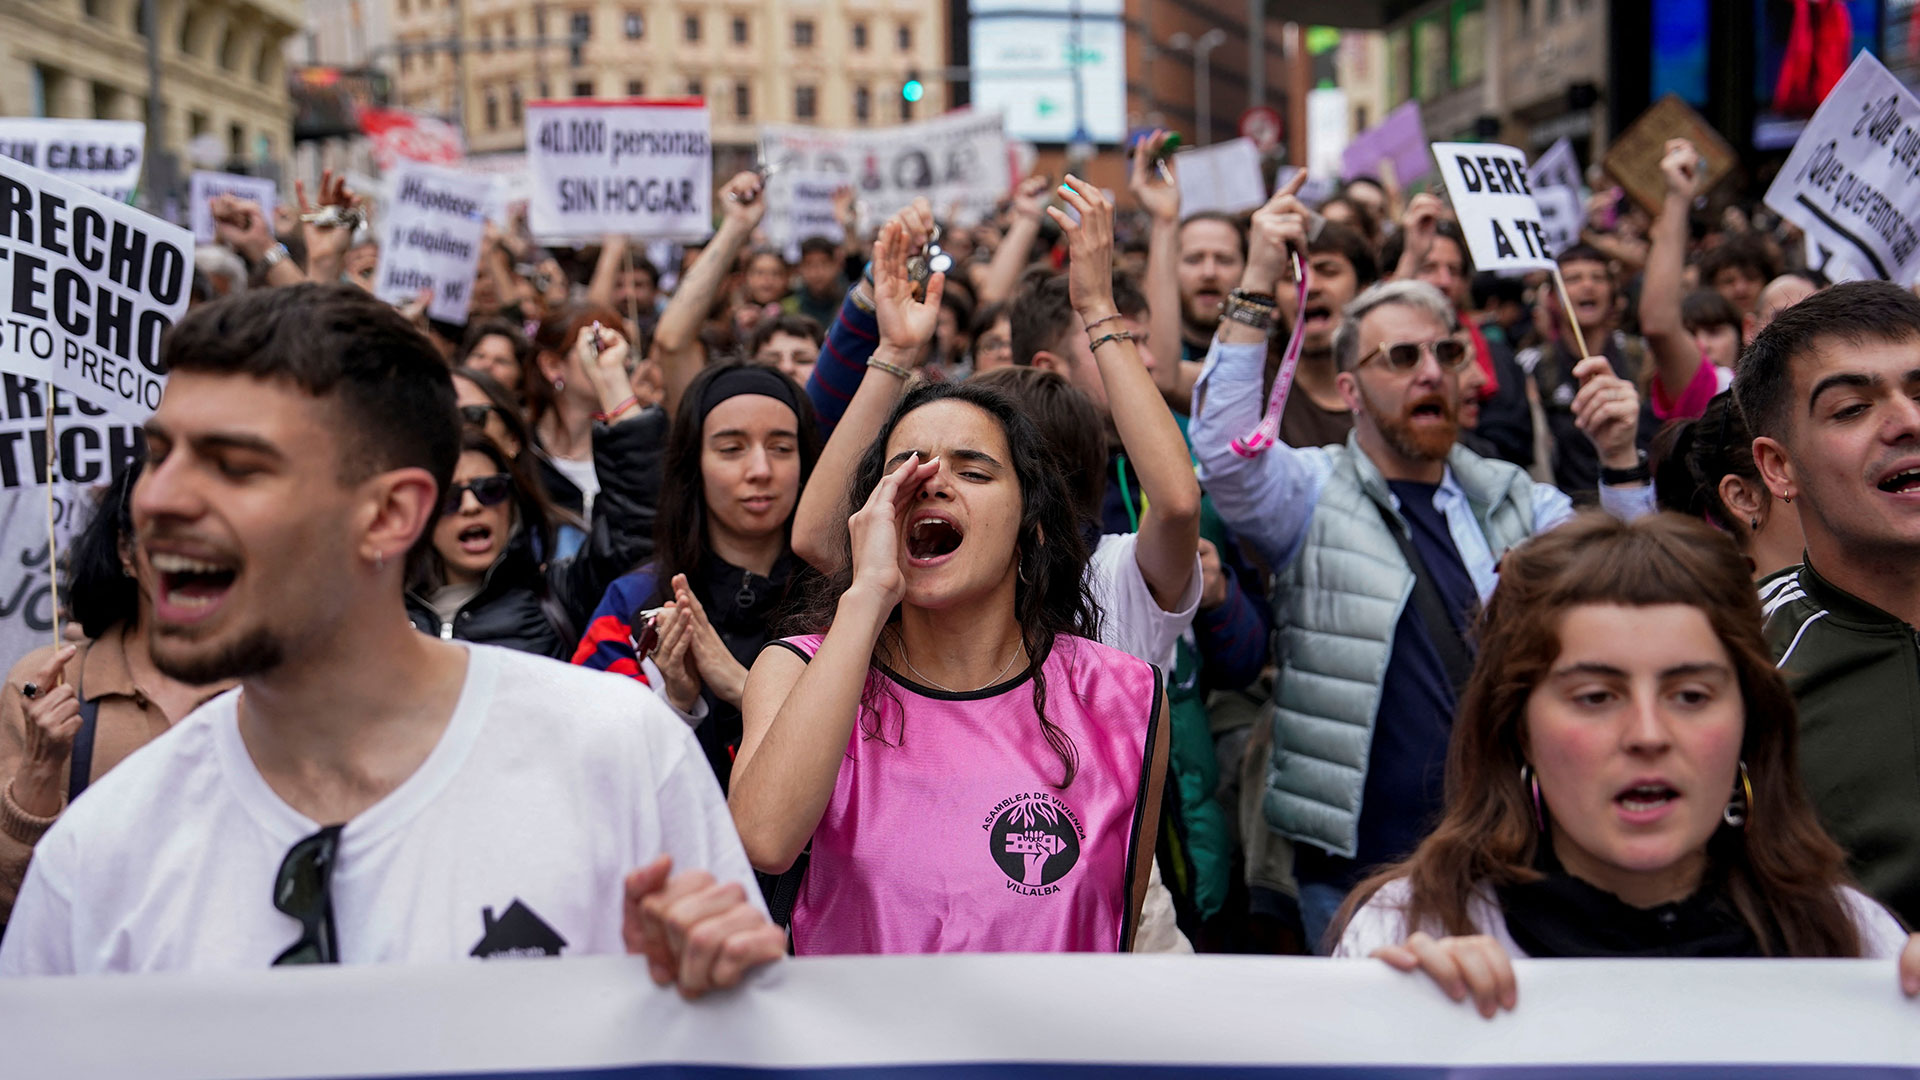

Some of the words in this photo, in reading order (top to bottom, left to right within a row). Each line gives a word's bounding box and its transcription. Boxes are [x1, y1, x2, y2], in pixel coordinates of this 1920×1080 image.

[47, 143, 136, 171] CASA?
[538, 119, 606, 155] 40.000
[611, 129, 711, 166] personas
[558, 177, 597, 214] SIN
[0, 174, 185, 306] RECHO
[1492, 218, 1519, 259] A
[0, 247, 173, 377] ECHO
[0, 316, 54, 360] TO
[64, 337, 162, 412] PRECIO
[982, 792, 1031, 831] ASAMBLEA
[1033, 792, 1049, 801] DE
[1051, 796, 1087, 841] VIVIENDA
[1006, 880, 1061, 897] VILLALBA
